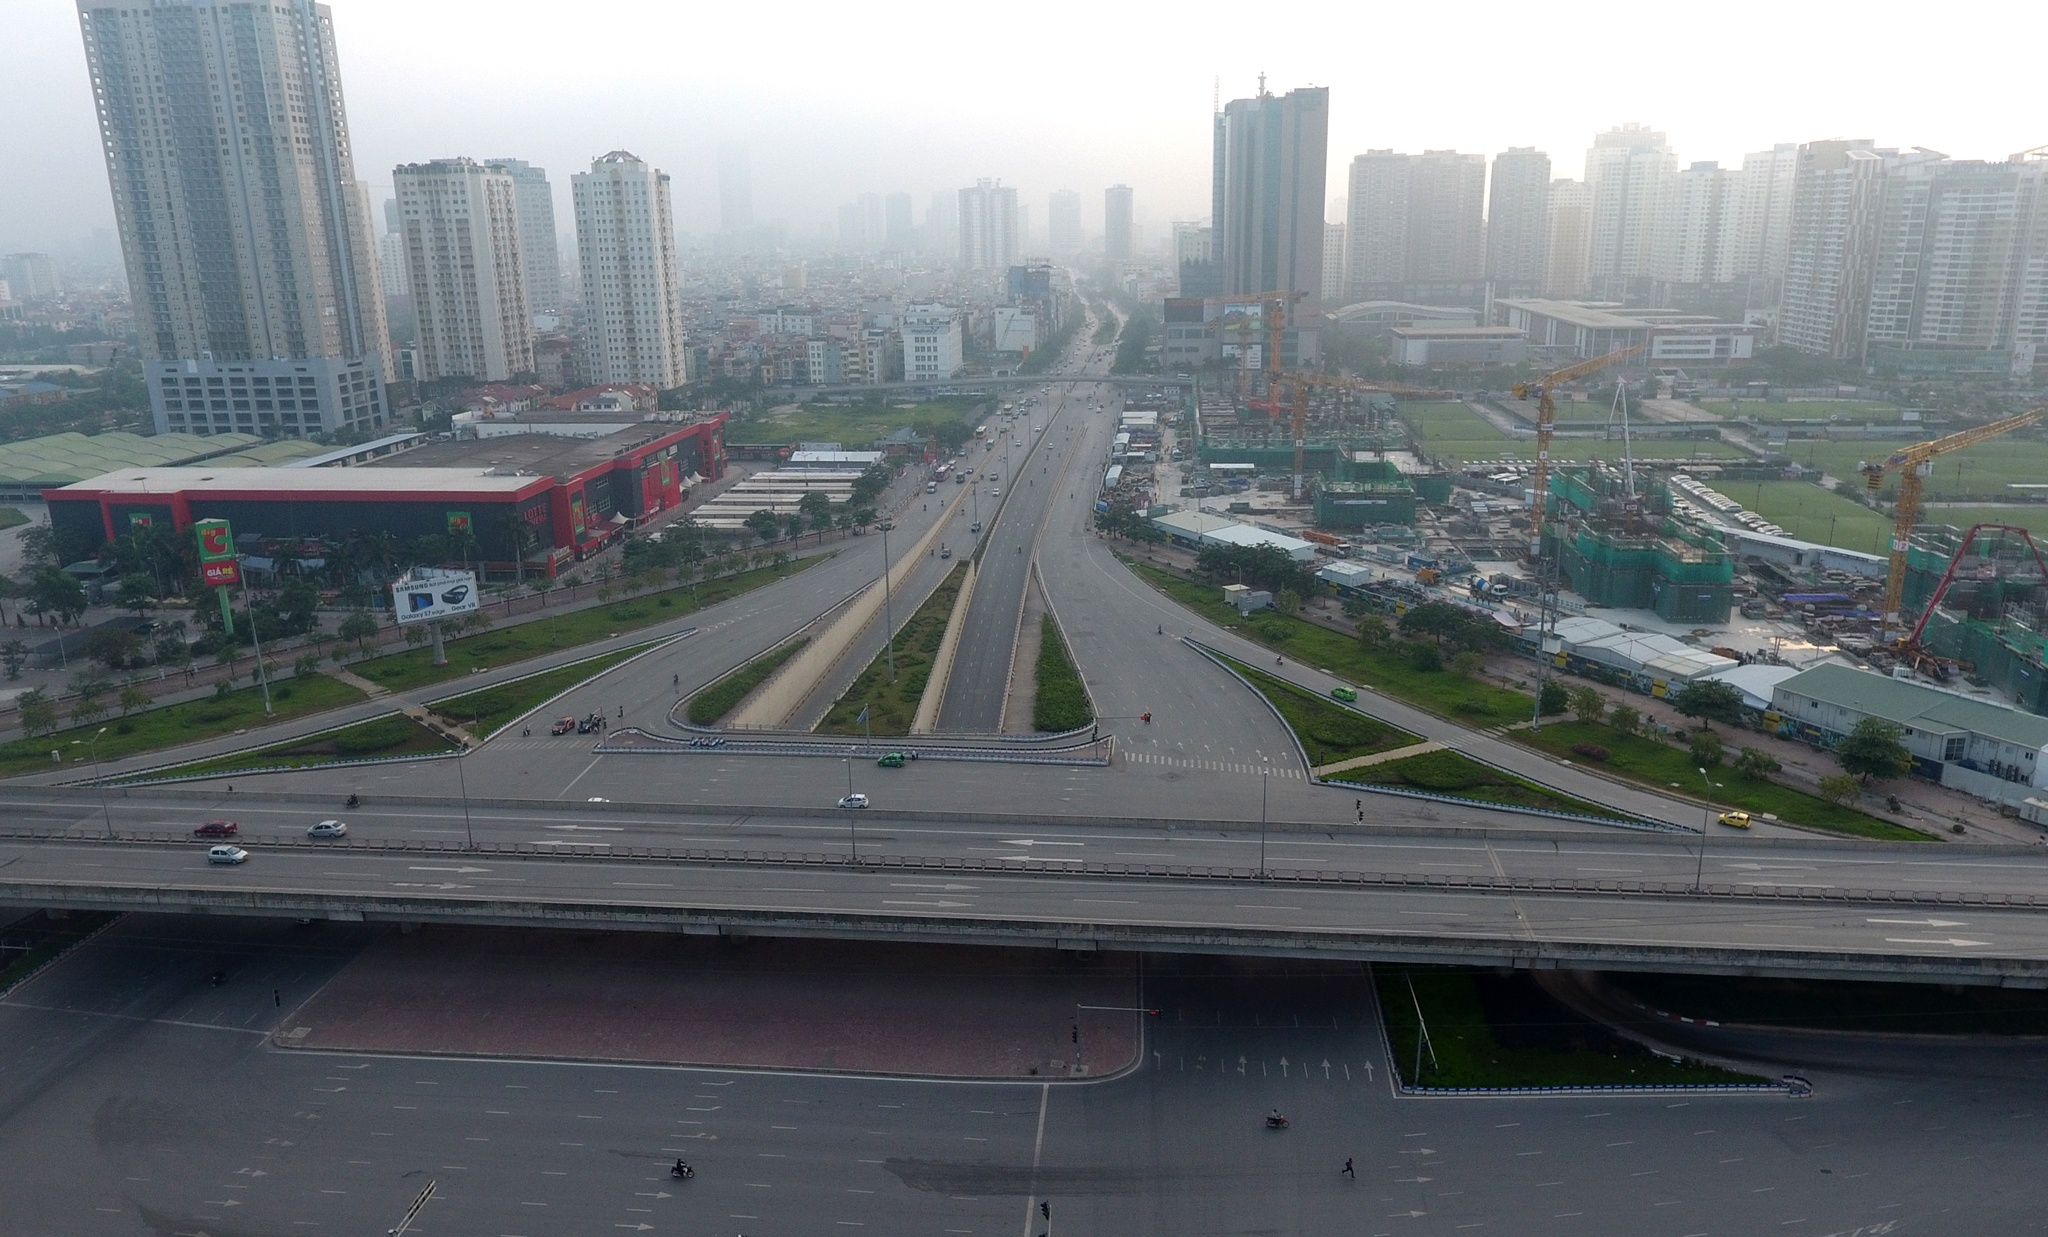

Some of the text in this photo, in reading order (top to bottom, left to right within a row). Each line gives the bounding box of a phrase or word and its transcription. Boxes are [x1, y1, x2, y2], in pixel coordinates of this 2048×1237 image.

[524, 503, 547, 520] LOTTE
[201, 526, 227, 554] Big C
[396, 582, 429, 593] SAMSUNG
[451, 604, 466, 612] Gear
[401, 612, 424, 620] Galaxy
